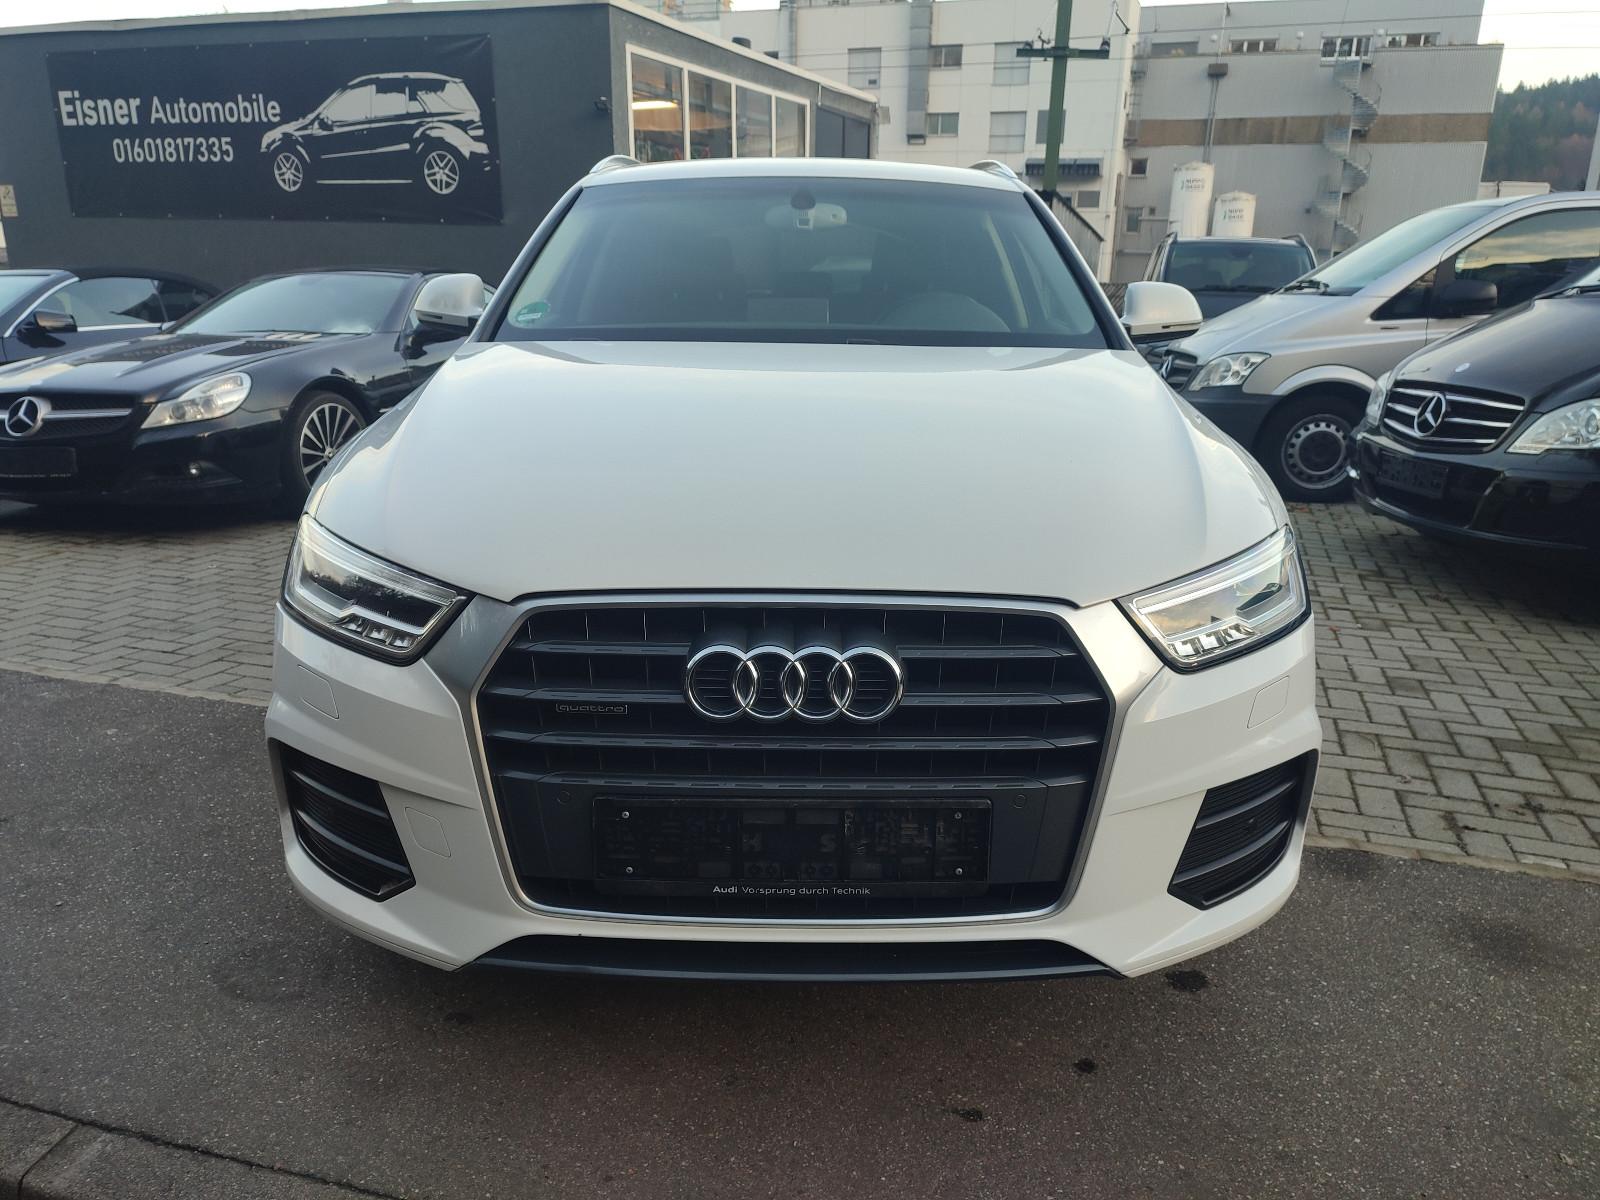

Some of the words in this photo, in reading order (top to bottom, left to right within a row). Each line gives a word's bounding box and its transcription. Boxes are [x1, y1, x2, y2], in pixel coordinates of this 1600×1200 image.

[58, 90, 141, 126] Eisner
[150, 93, 281, 125] Automobile
[112, 136, 234, 163] 01601817335
[558, 704, 625, 713] quattro
[712, 885, 738, 894] Audi
[742, 886, 796, 896] Vorsprung
[799, 886, 829, 895] durch
[831, 887, 871, 895] Technik
